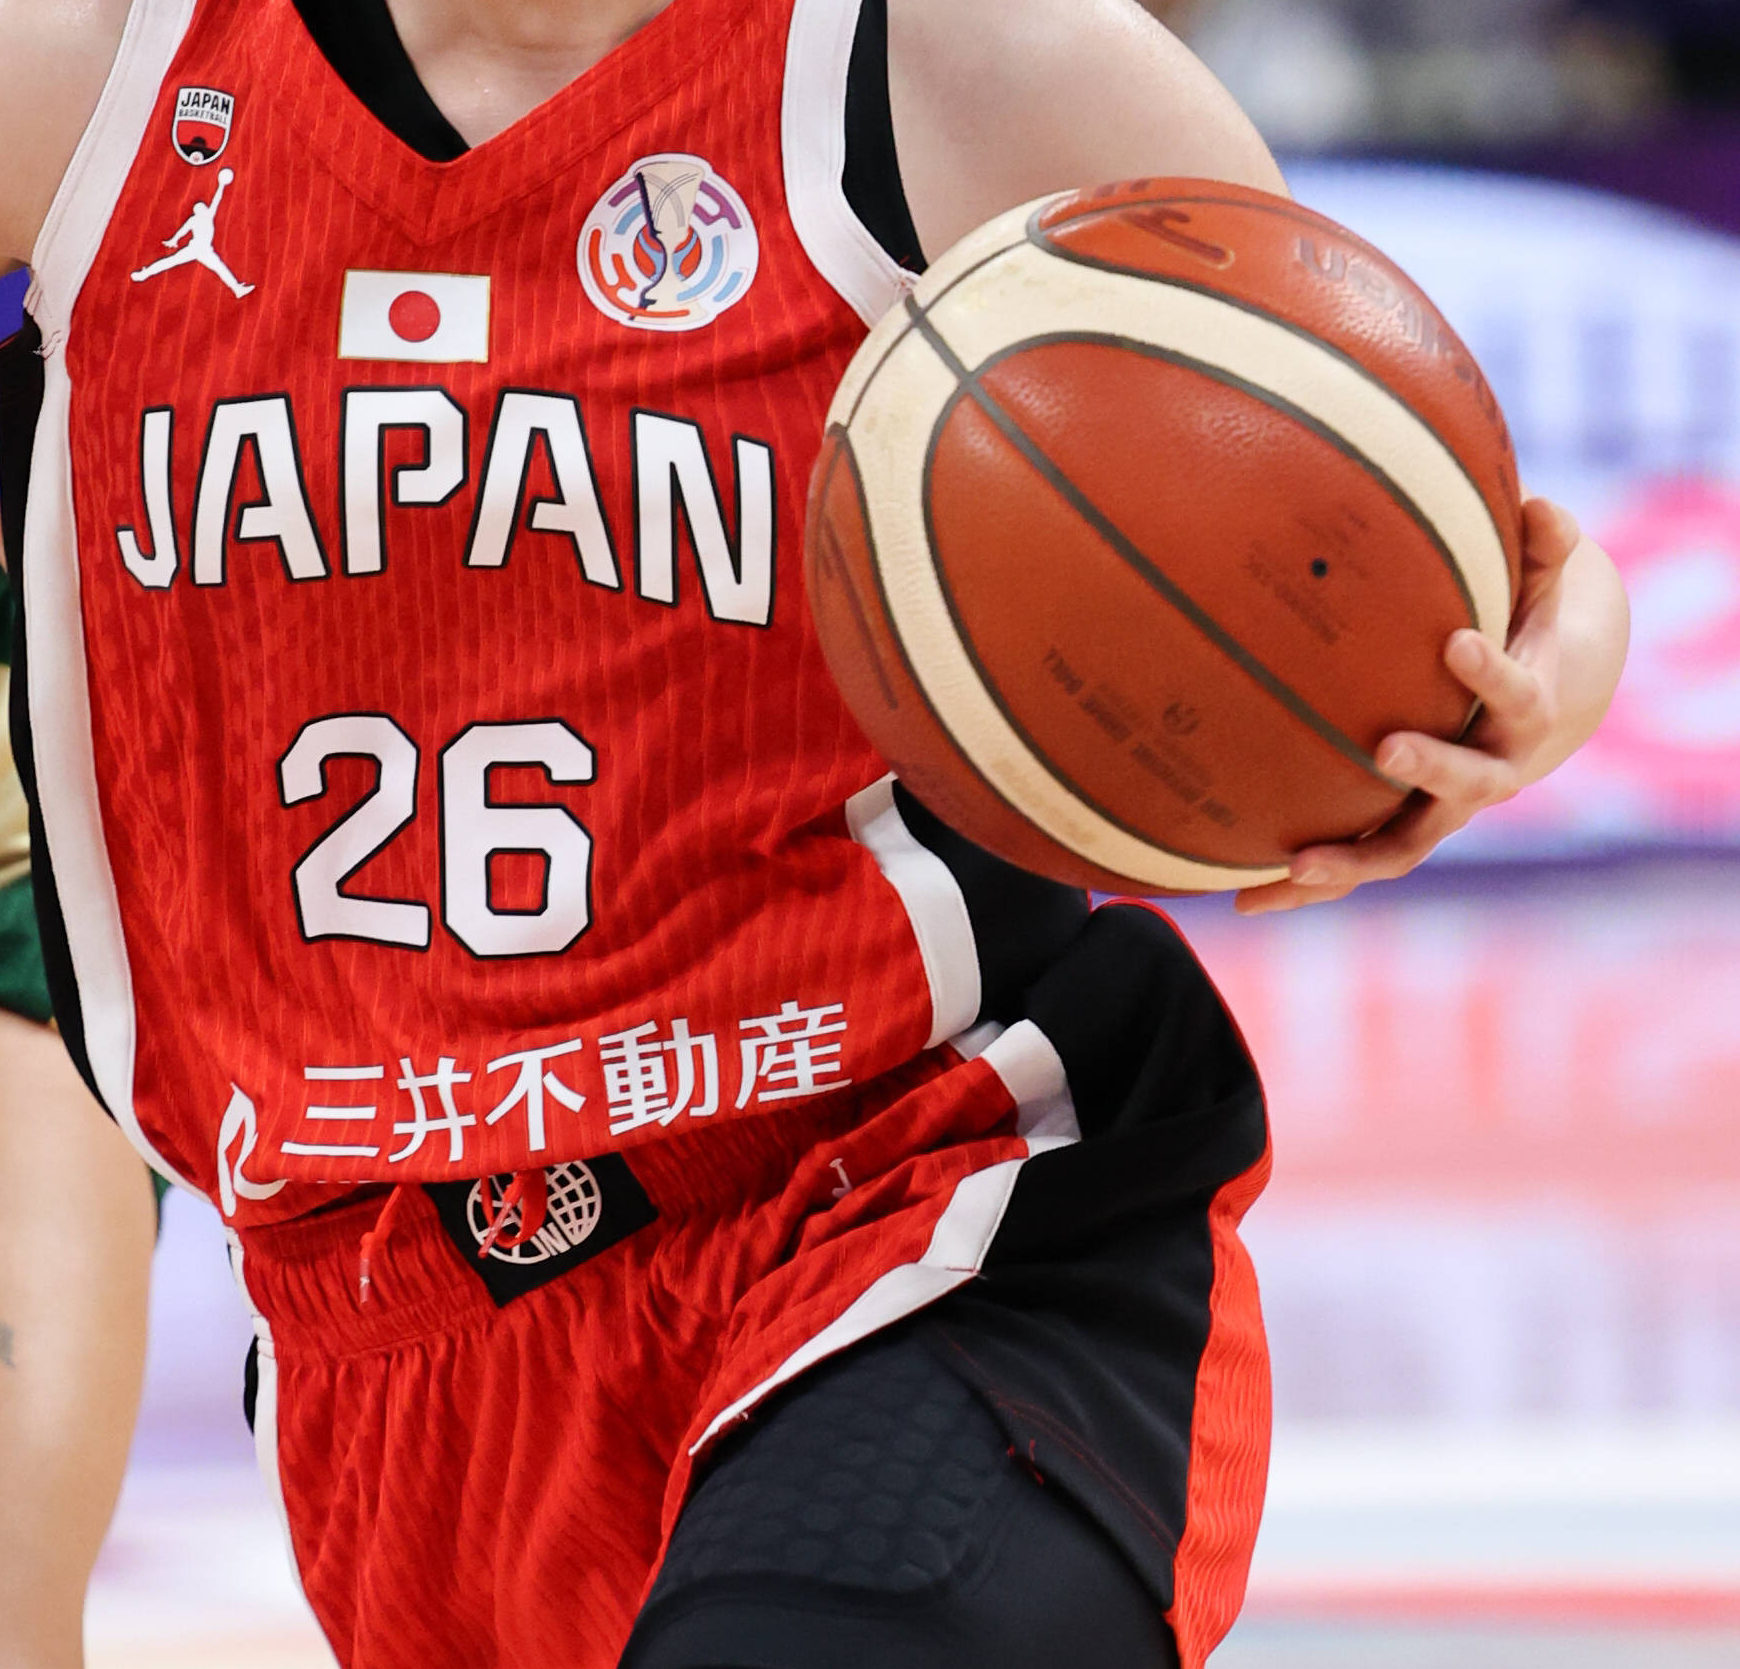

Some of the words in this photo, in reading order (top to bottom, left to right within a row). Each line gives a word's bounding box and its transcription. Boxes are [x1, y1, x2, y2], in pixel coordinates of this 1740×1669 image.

[181, 91, 230, 115] JAPAN
[116, 384, 777, 628] JAPAN
[276, 710, 597, 962] 26
[280, 1000, 853, 1164] 三井不動産
